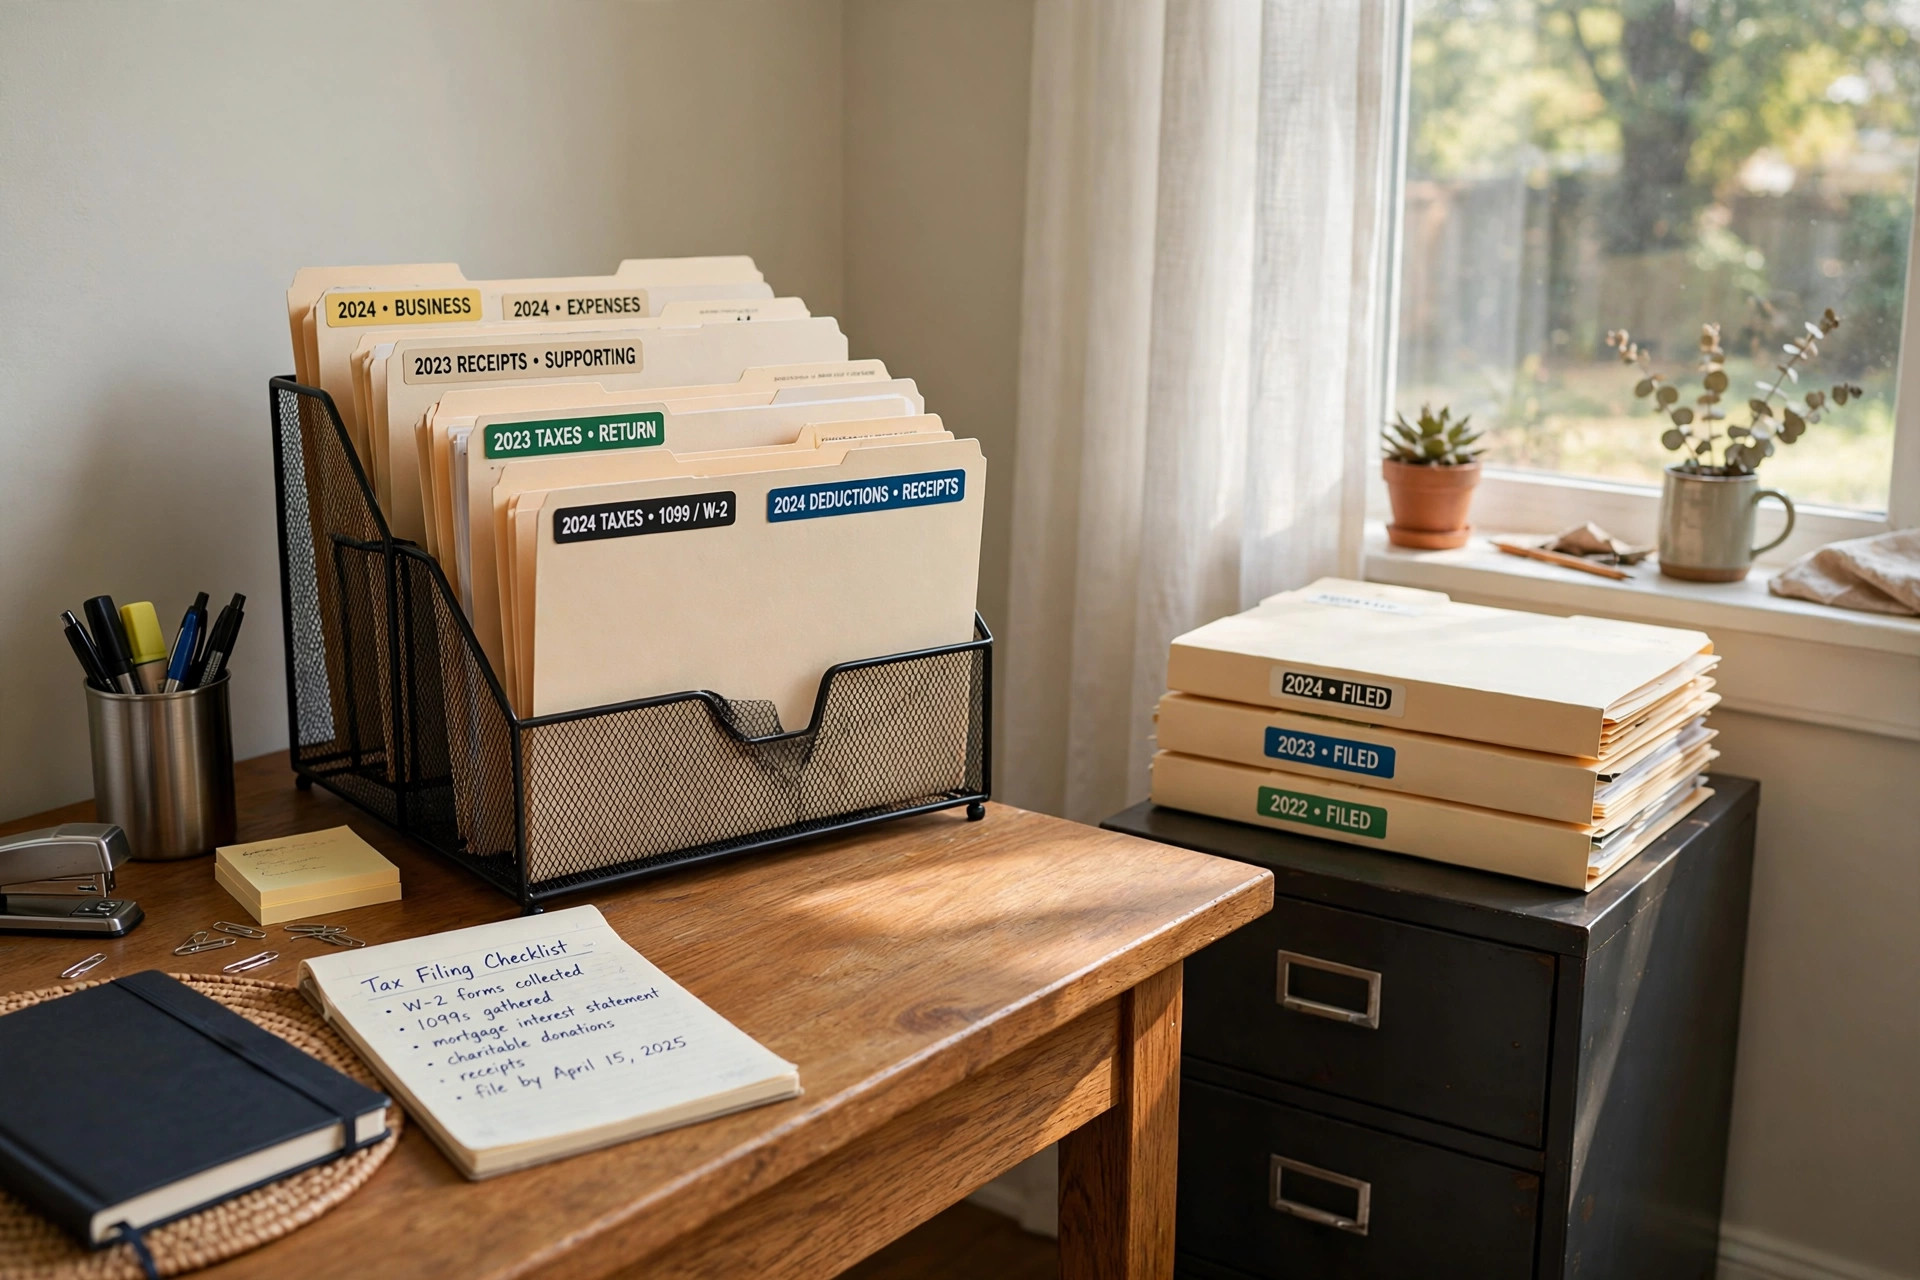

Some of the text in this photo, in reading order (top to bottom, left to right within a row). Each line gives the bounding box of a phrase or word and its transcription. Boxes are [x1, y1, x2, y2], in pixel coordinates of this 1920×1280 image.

[337, 297, 471, 319] 2024 BUSINESS
[514, 297, 640, 318] 2024 EXPENSES
[414, 347, 636, 375] 2023 RECEIPTS SUPPORTING
[494, 420, 656, 450] 2023 TAXES RETURN
[774, 477, 959, 514] 2024 DEDUCTIONS RECEIPTS
[562, 514, 596, 535] 2024
[599, 509, 644, 531] TAXES
[659, 504, 690, 525] 1099
[702, 501, 728, 520] W-2
[1284, 674, 1388, 708] 2024 FILED
[1277, 735, 1379, 769] 2023 FILED
[1270, 794, 1371, 830] 2022 FILED
[360, 940, 567, 993] Tax Filing Checklist
[402, 963, 584, 1012] W-2 forms collected
[418, 990, 553, 1031] 1099s gathered
[432, 987, 660, 1048] mortgage interest statement
[448, 1019, 615, 1065] charitable donations
[460, 1058, 525, 1081] receipts
[475, 1083, 508, 1098] file
[518, 1075, 542, 1090] by
[554, 1058, 595, 1081] April
[640, 1035, 687, 1057] 2025
